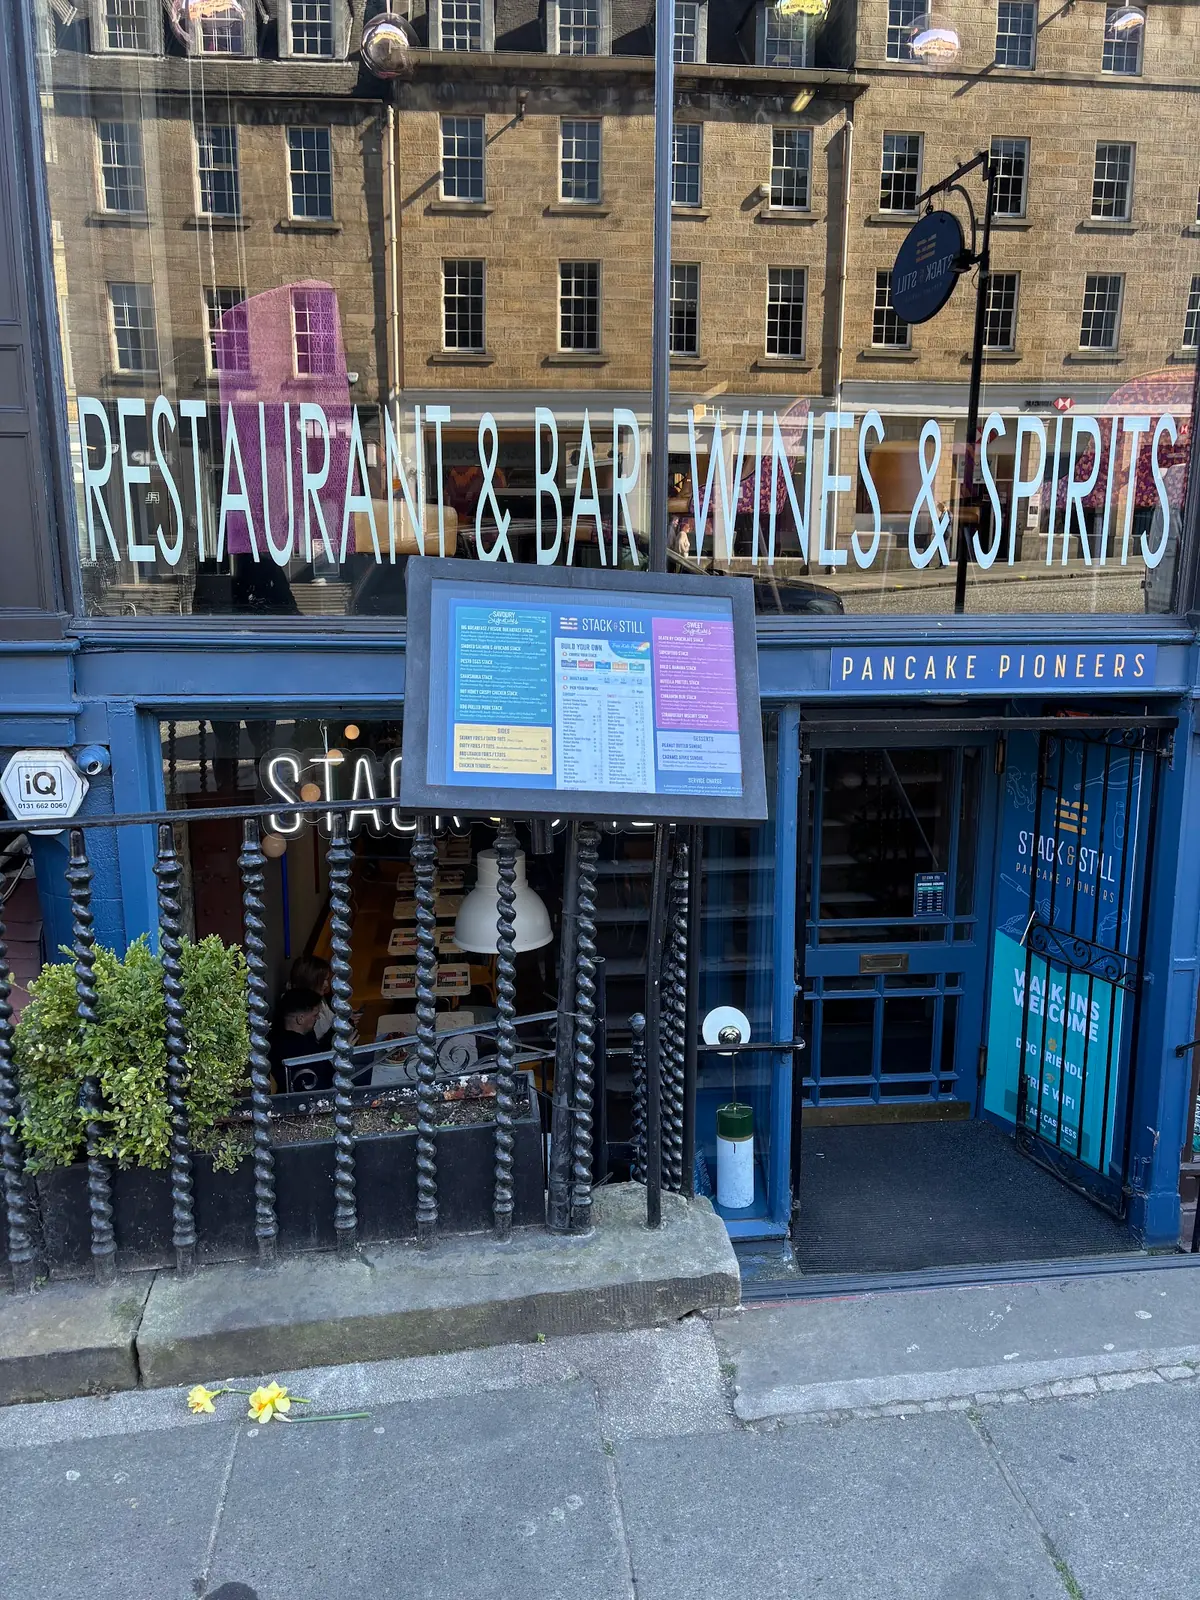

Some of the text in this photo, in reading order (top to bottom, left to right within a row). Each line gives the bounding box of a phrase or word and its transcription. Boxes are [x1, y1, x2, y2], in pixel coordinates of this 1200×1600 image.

[79, 395, 640, 568] RESTAURANT & BAR
[688, 408, 1178, 570] WINES & SPIRITS
[582, 618, 612, 632] STACK
[619, 620, 645, 634] STILL
[576, 643, 590, 651] YOUR
[842, 653, 1145, 681] PANCAKE PIONEERS
[25, 771, 57, 796] iQ
[267, 756, 460, 833] STAC
[1018, 830, 1115, 883] STACK & STLL
